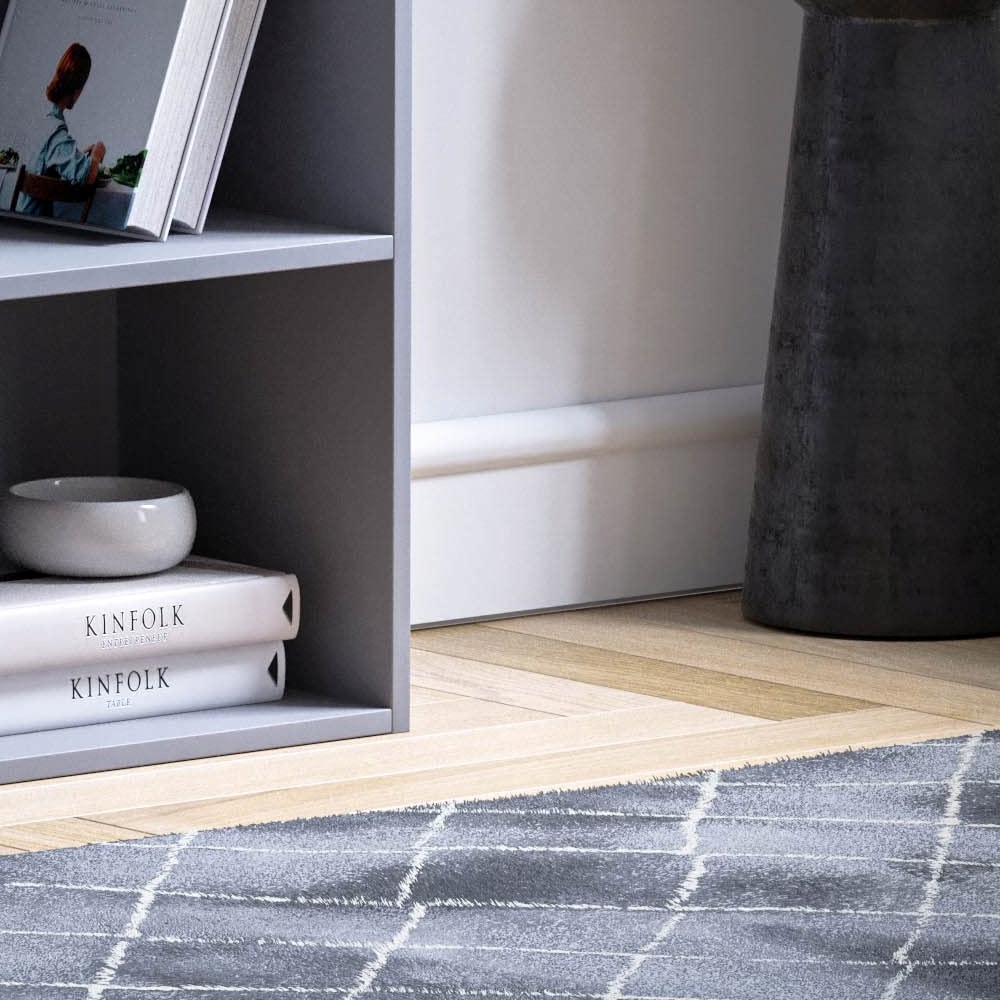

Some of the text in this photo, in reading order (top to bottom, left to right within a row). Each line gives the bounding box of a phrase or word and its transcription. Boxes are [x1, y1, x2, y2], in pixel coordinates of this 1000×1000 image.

[85, 604, 185, 637] KINFOLK
[70, 666, 170, 700] KINFOLK
[105, 698, 131, 709] TABLE
